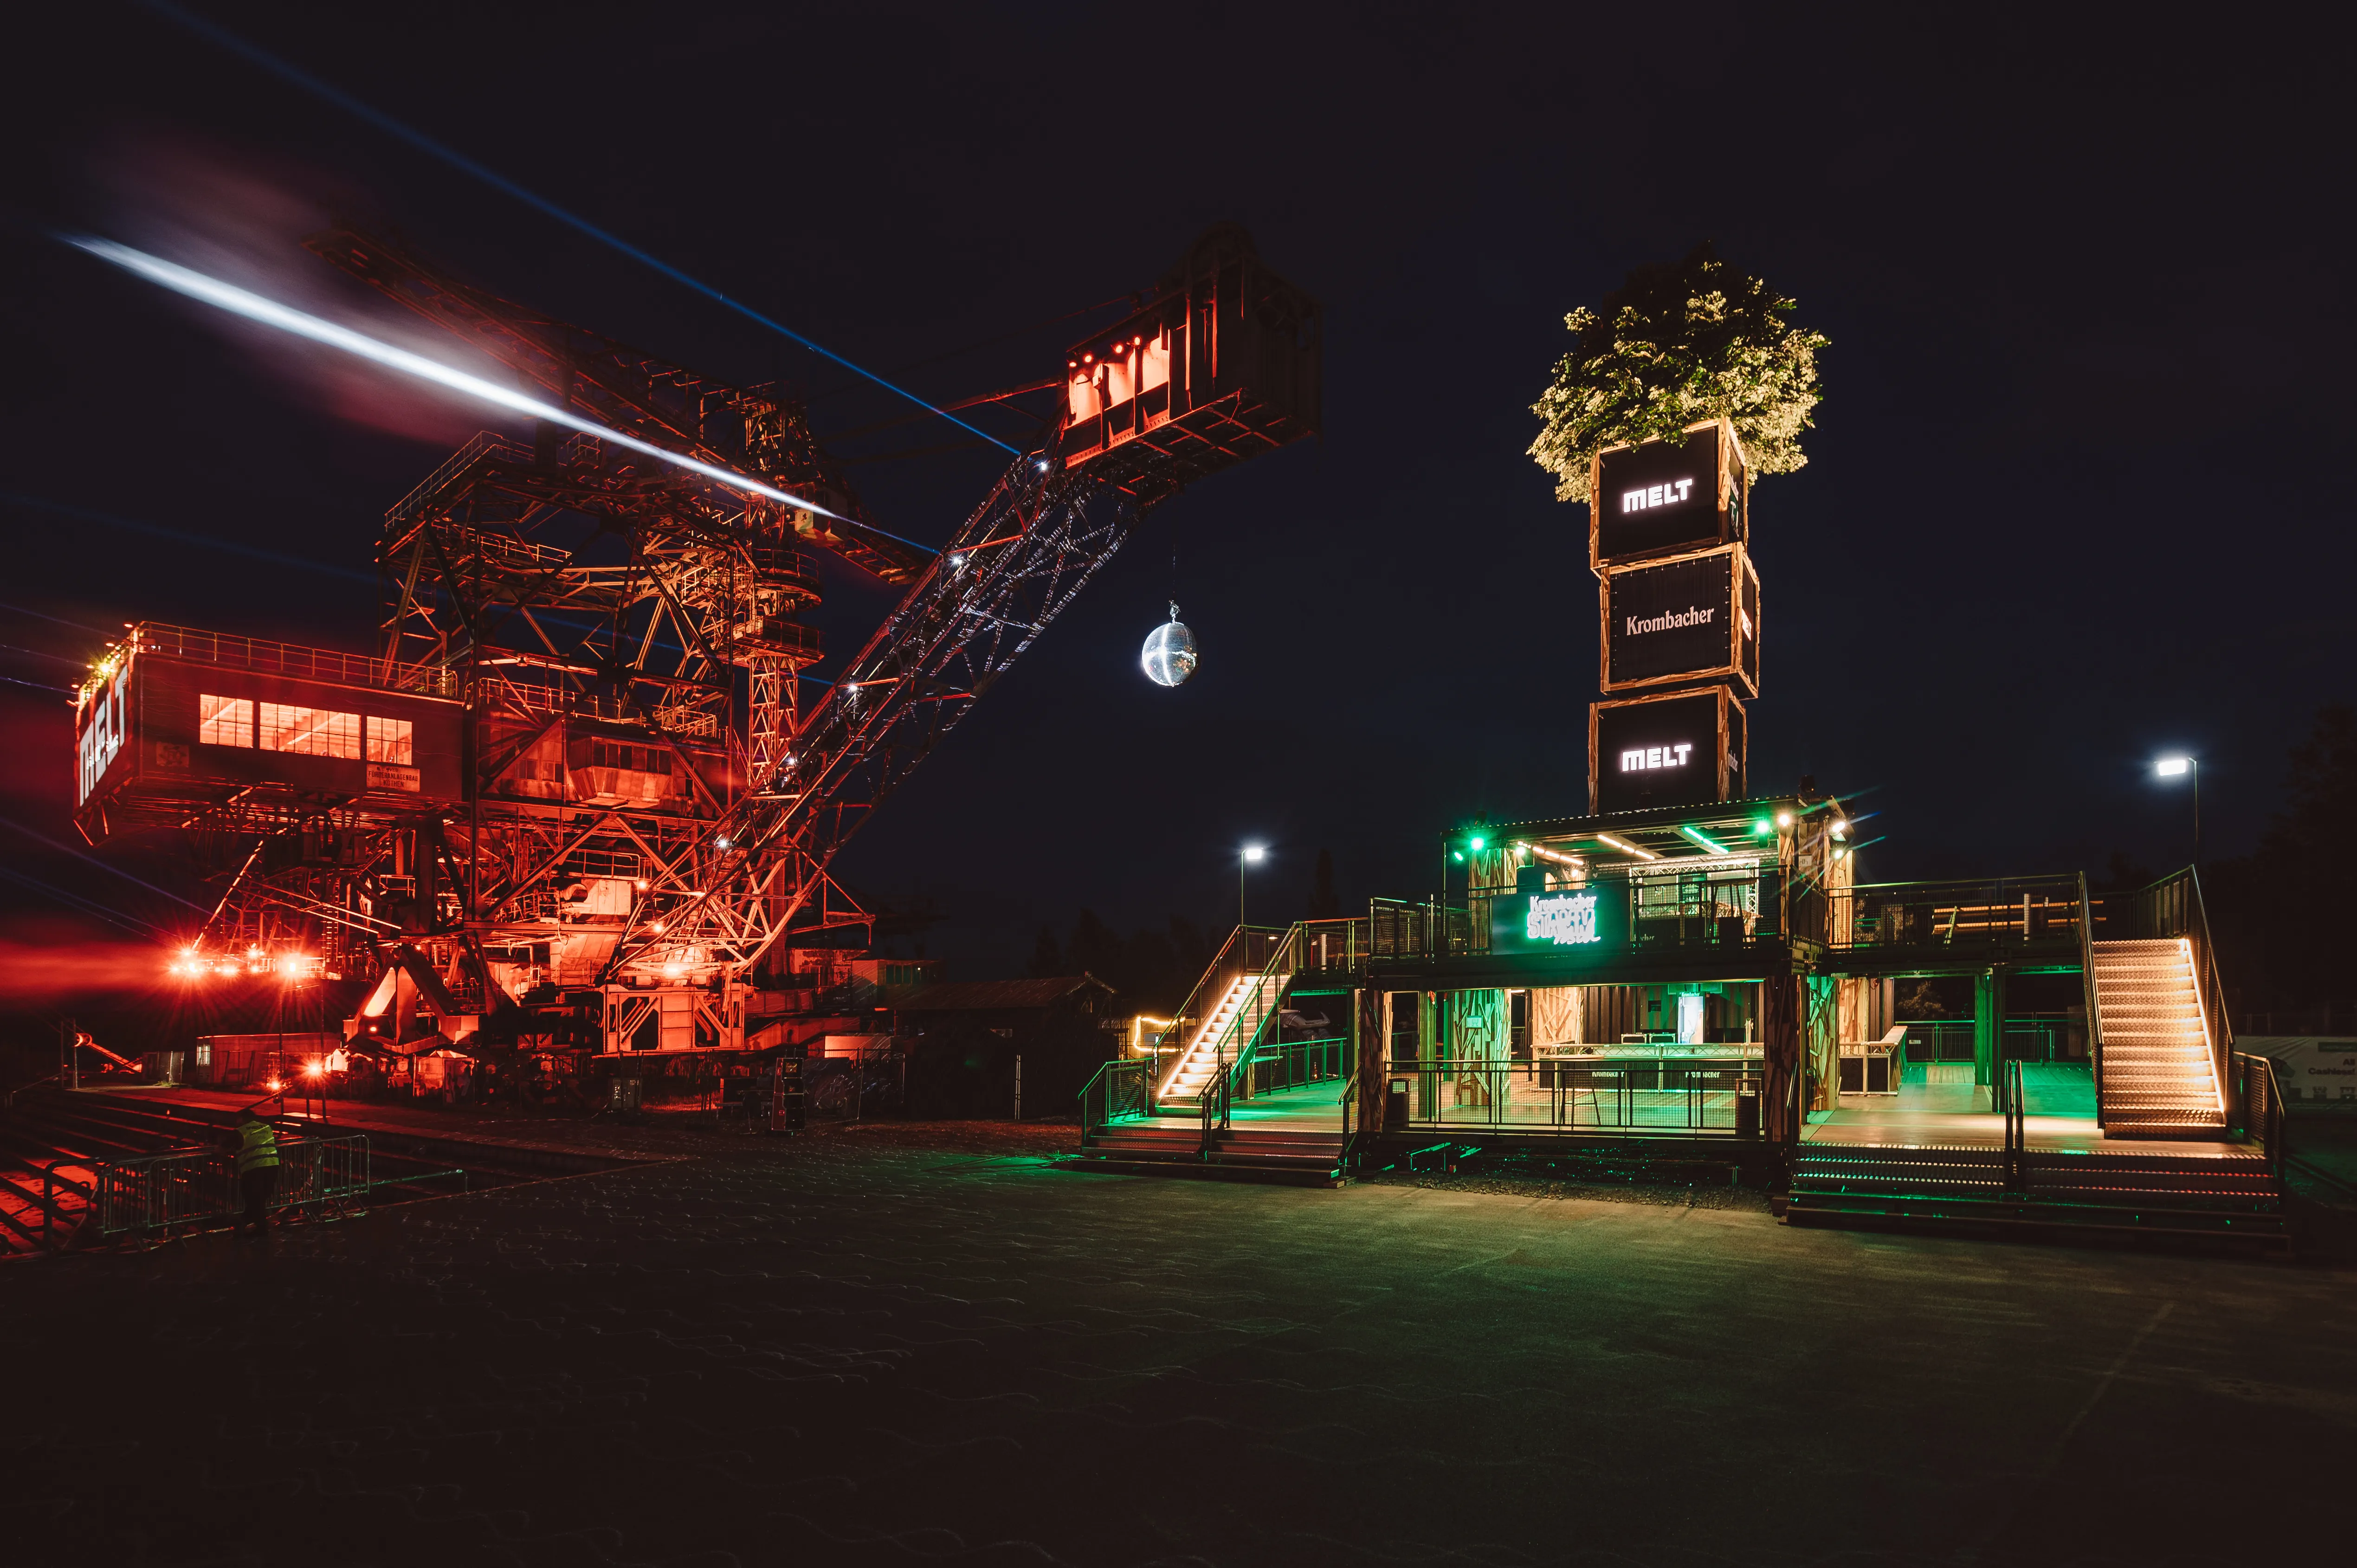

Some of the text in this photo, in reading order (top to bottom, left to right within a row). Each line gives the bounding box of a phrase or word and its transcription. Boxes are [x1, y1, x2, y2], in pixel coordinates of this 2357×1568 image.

[1623, 478, 1693, 513] MELT
[1627, 606, 1714, 636] Krombacher
[80, 665, 128, 807] MELT
[1622, 743, 1692, 772] MELT
